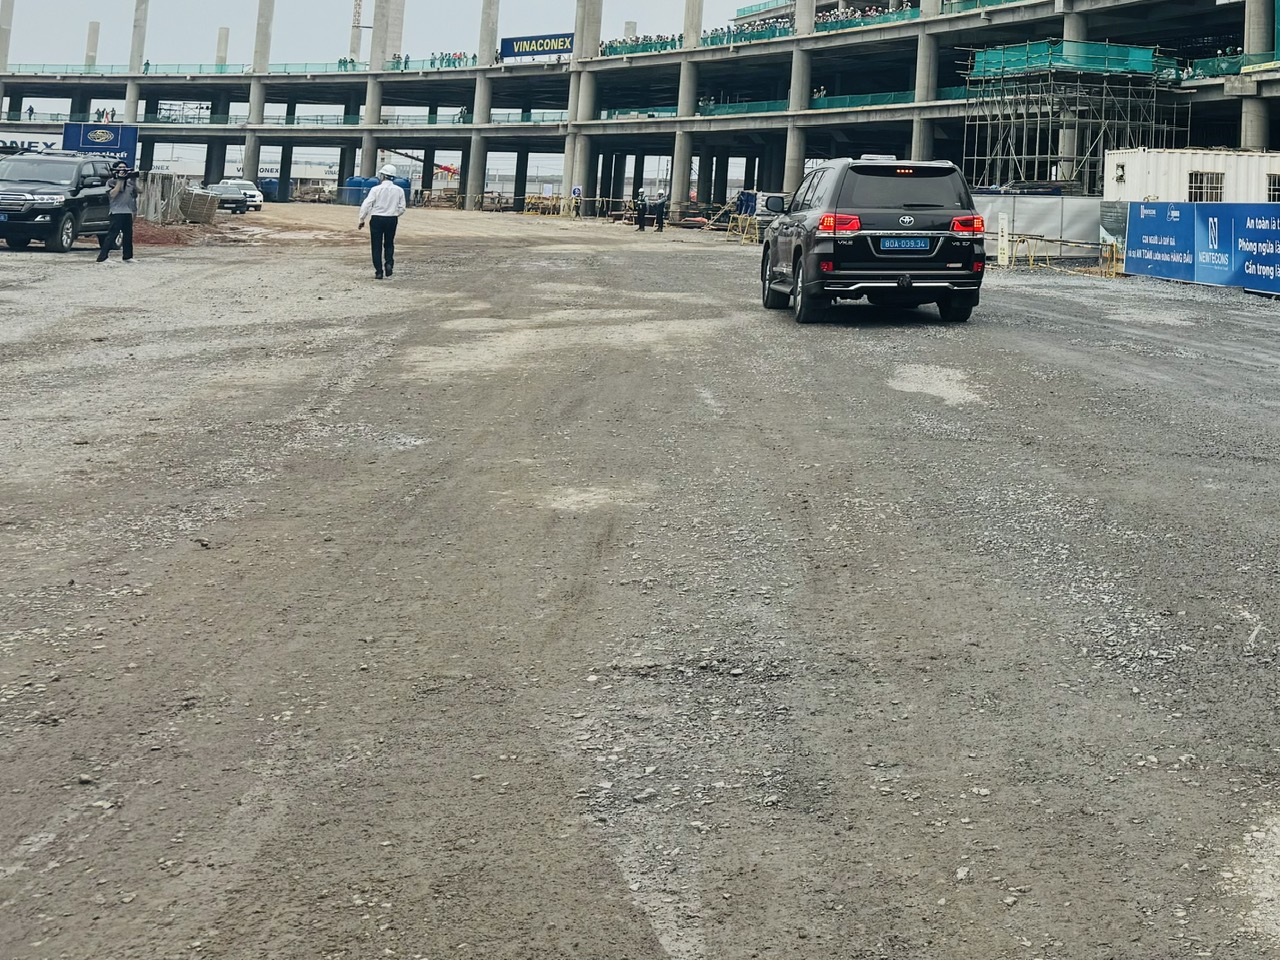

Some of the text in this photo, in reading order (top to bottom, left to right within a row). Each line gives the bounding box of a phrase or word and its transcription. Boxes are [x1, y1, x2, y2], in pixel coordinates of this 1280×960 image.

[513, 37, 572, 53] VINACONEX
[1246, 216, 1255, 229] An
[1255, 216, 1270, 230] toàn
[1271, 216, 1276, 230] là
[1238, 238, 1258, 257] Phòng
[1275, 239, 1280, 254] là
[1199, 251, 1229, 266] NEWTECONS
[1256, 263, 1274, 280] trọng
[1275, 262, 1280, 277] là
